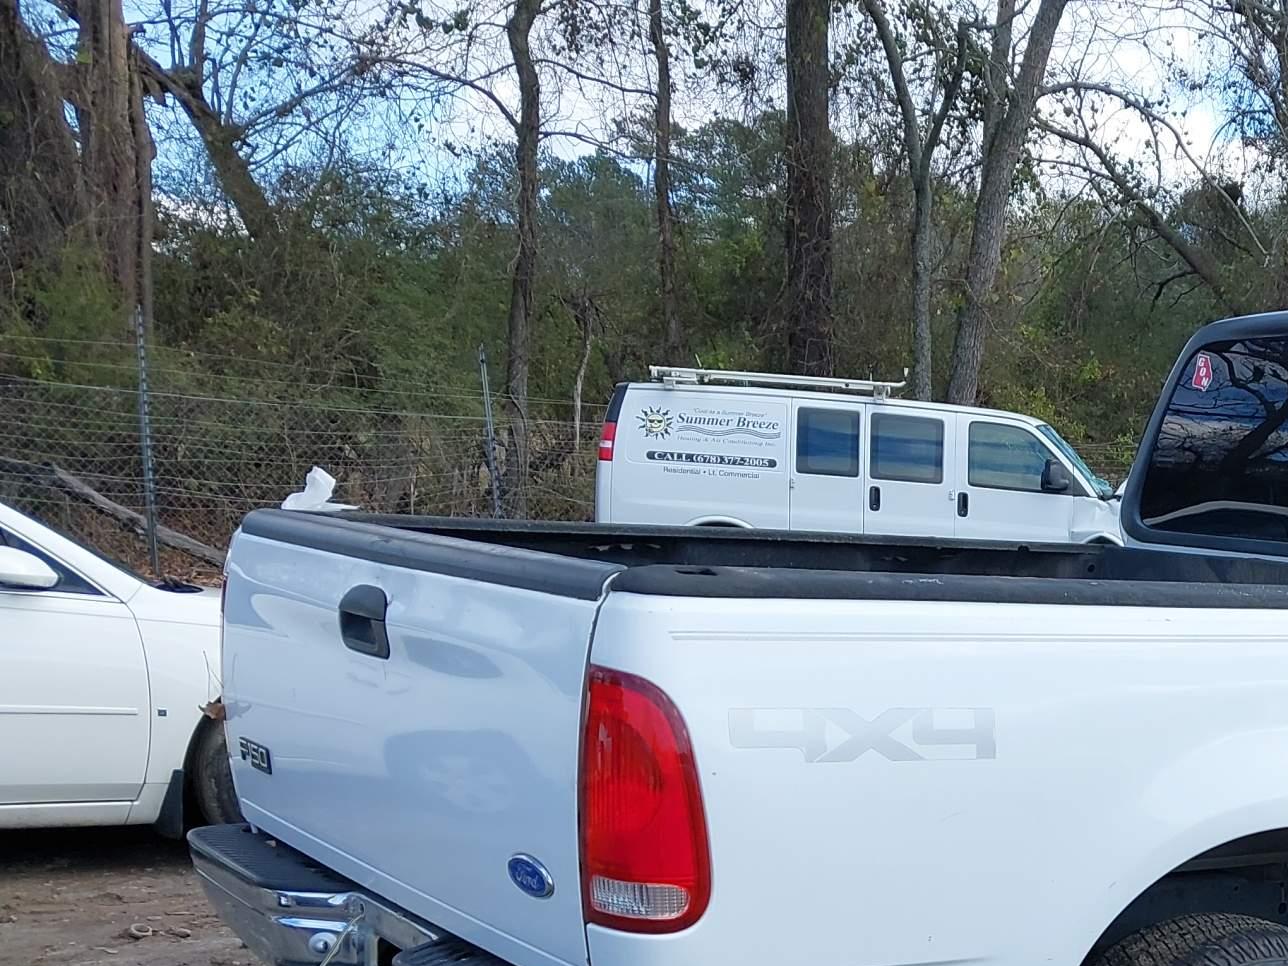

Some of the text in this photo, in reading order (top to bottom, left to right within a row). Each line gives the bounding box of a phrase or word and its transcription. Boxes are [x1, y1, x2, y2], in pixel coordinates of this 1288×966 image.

[676, 412, 780, 431] Summer Breeze
[654, 452, 770, 468] CALL (678) 377-2005
[663, 466, 701, 475] Residential
[718, 469, 760, 479] Commercial
[239, 738, 269, 770] F150
